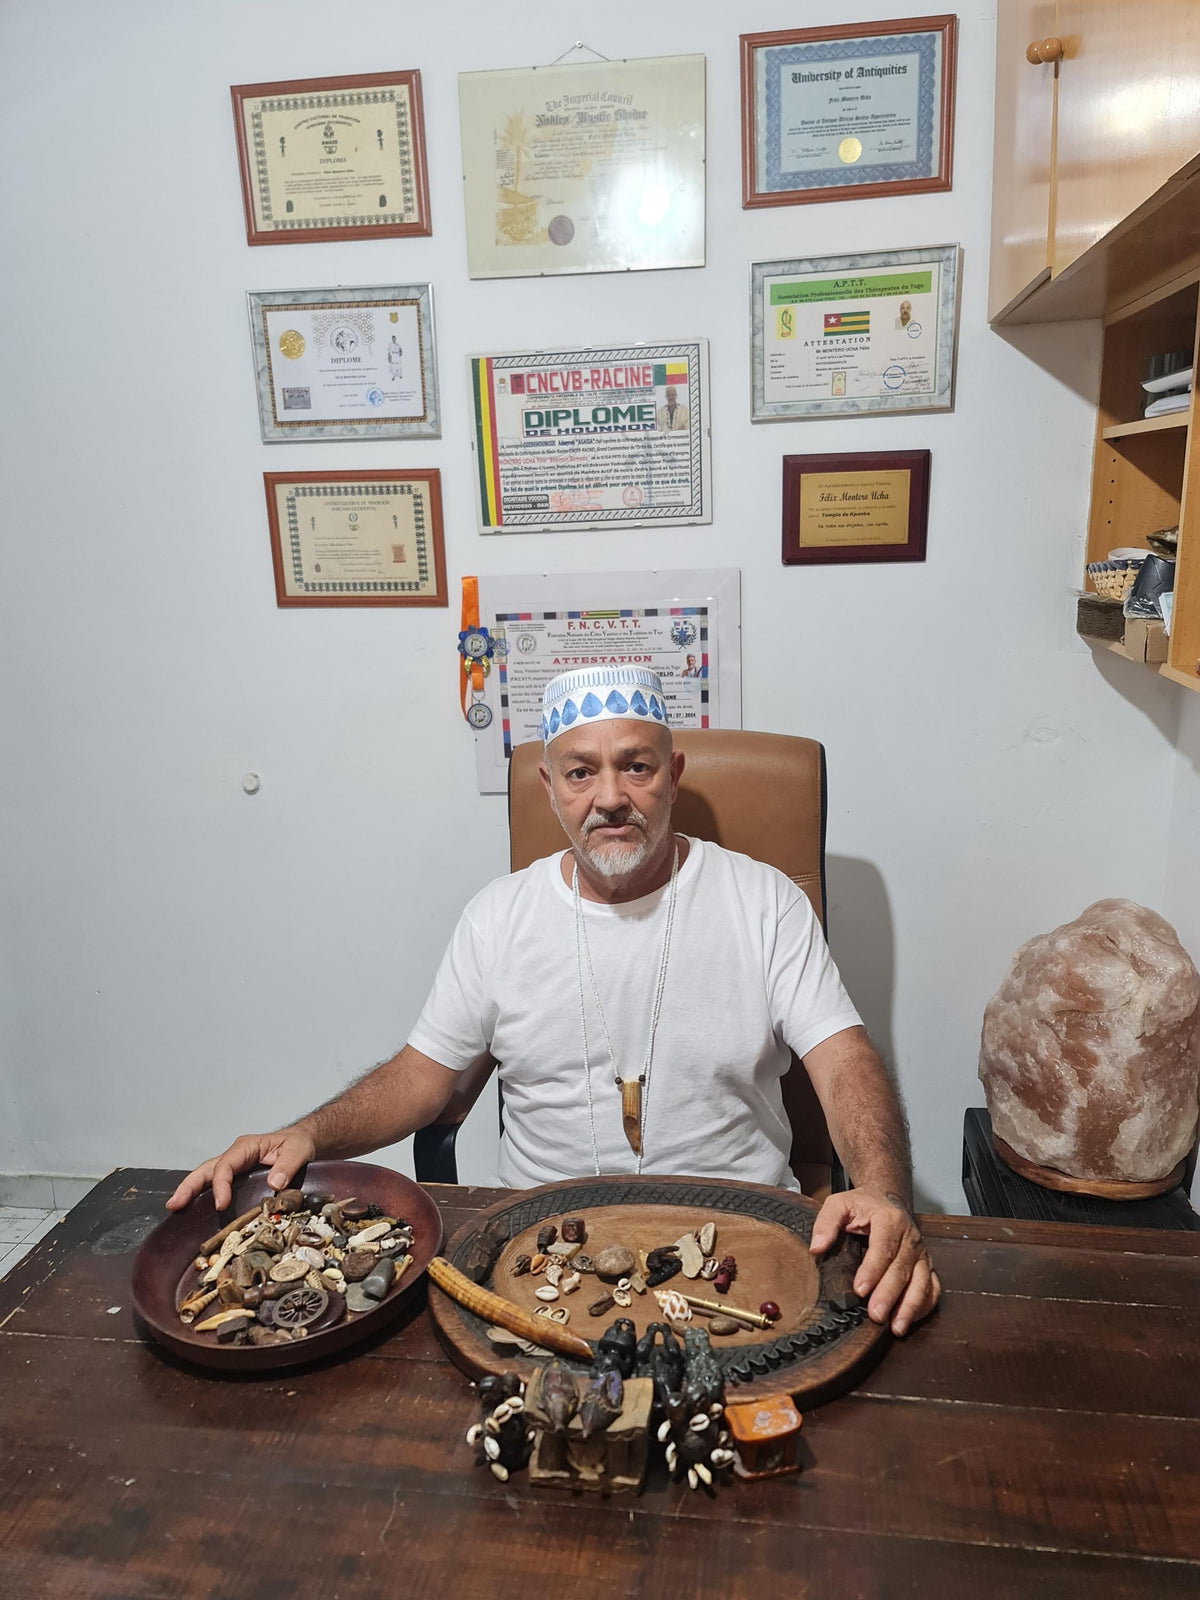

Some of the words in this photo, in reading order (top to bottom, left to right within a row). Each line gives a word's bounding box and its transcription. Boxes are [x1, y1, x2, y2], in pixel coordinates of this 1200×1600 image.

[791, 70, 842, 84] University
[844, 68, 854, 80] of
[856, 64, 908, 79] Antiquities
[563, 92, 600, 105] Imperial
[833, 279, 866, 288] A.P.T.T.
[803, 336, 872, 347] ATTESTATION
[526, 366, 652, 394] CNCVB-RACINE
[524, 404, 655, 429] DIPLOME
[525, 429, 552, 437] DE
[557, 423, 656, 435] HOUNNON
[839, 492, 868, 502] Montero
[871, 491, 889, 500] Ucha
[553, 655, 652, 665] ATTESTATION
